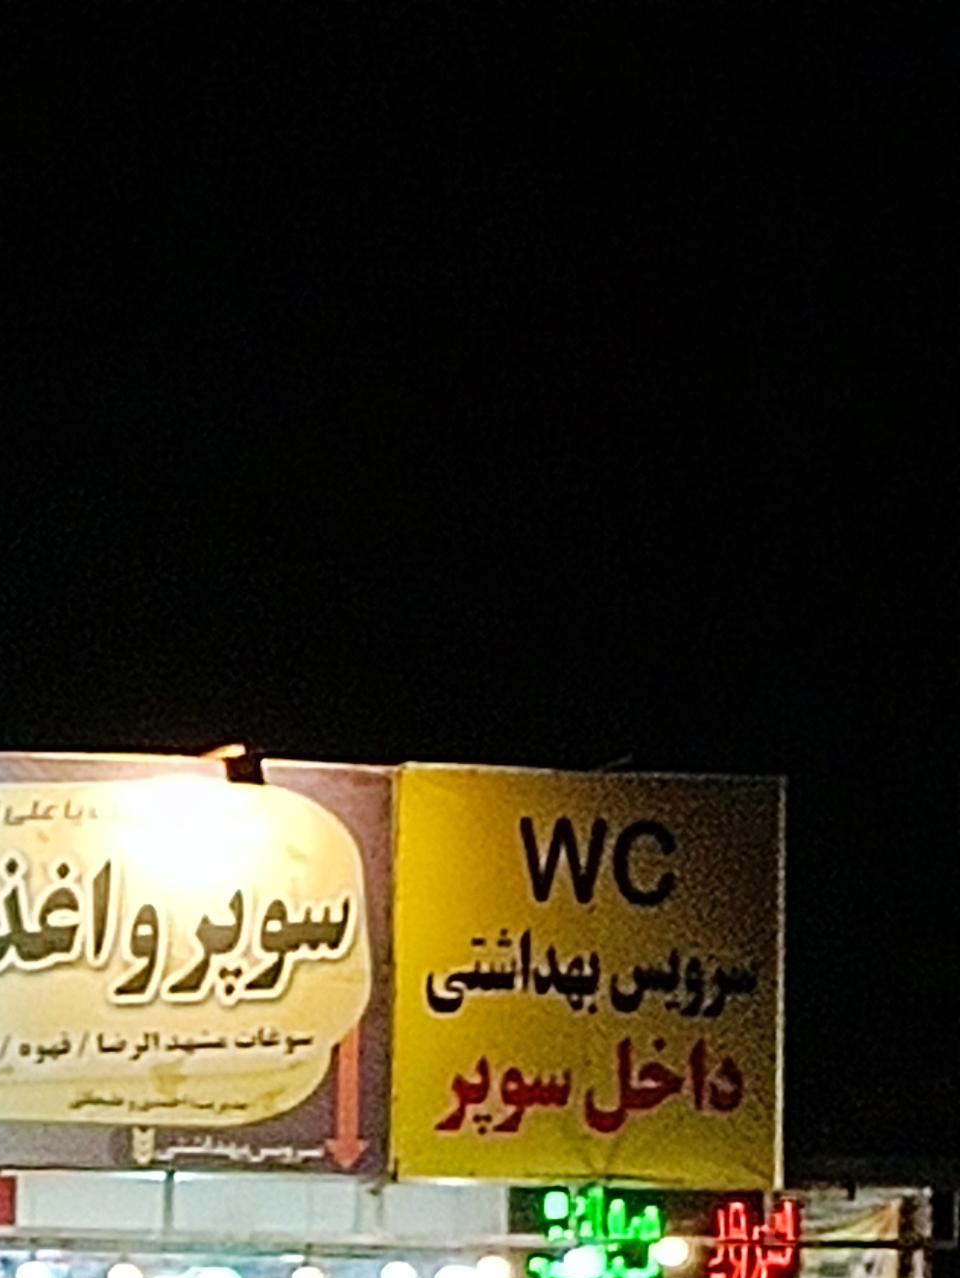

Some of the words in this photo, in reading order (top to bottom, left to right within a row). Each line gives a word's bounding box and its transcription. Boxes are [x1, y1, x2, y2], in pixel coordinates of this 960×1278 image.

[520, 816, 677, 907] WC
[114, 903, 160, 997] و
[166, 889, 351, 996] سوپر
[426, 928, 600, 1014] بهداشتی
[610, 949, 760, 1017] سرویس
[19, 1032, 72, 1063] قهوه
[585, 1036, 743, 1134] داخل
[435, 1055, 572, 1135] سوپر
